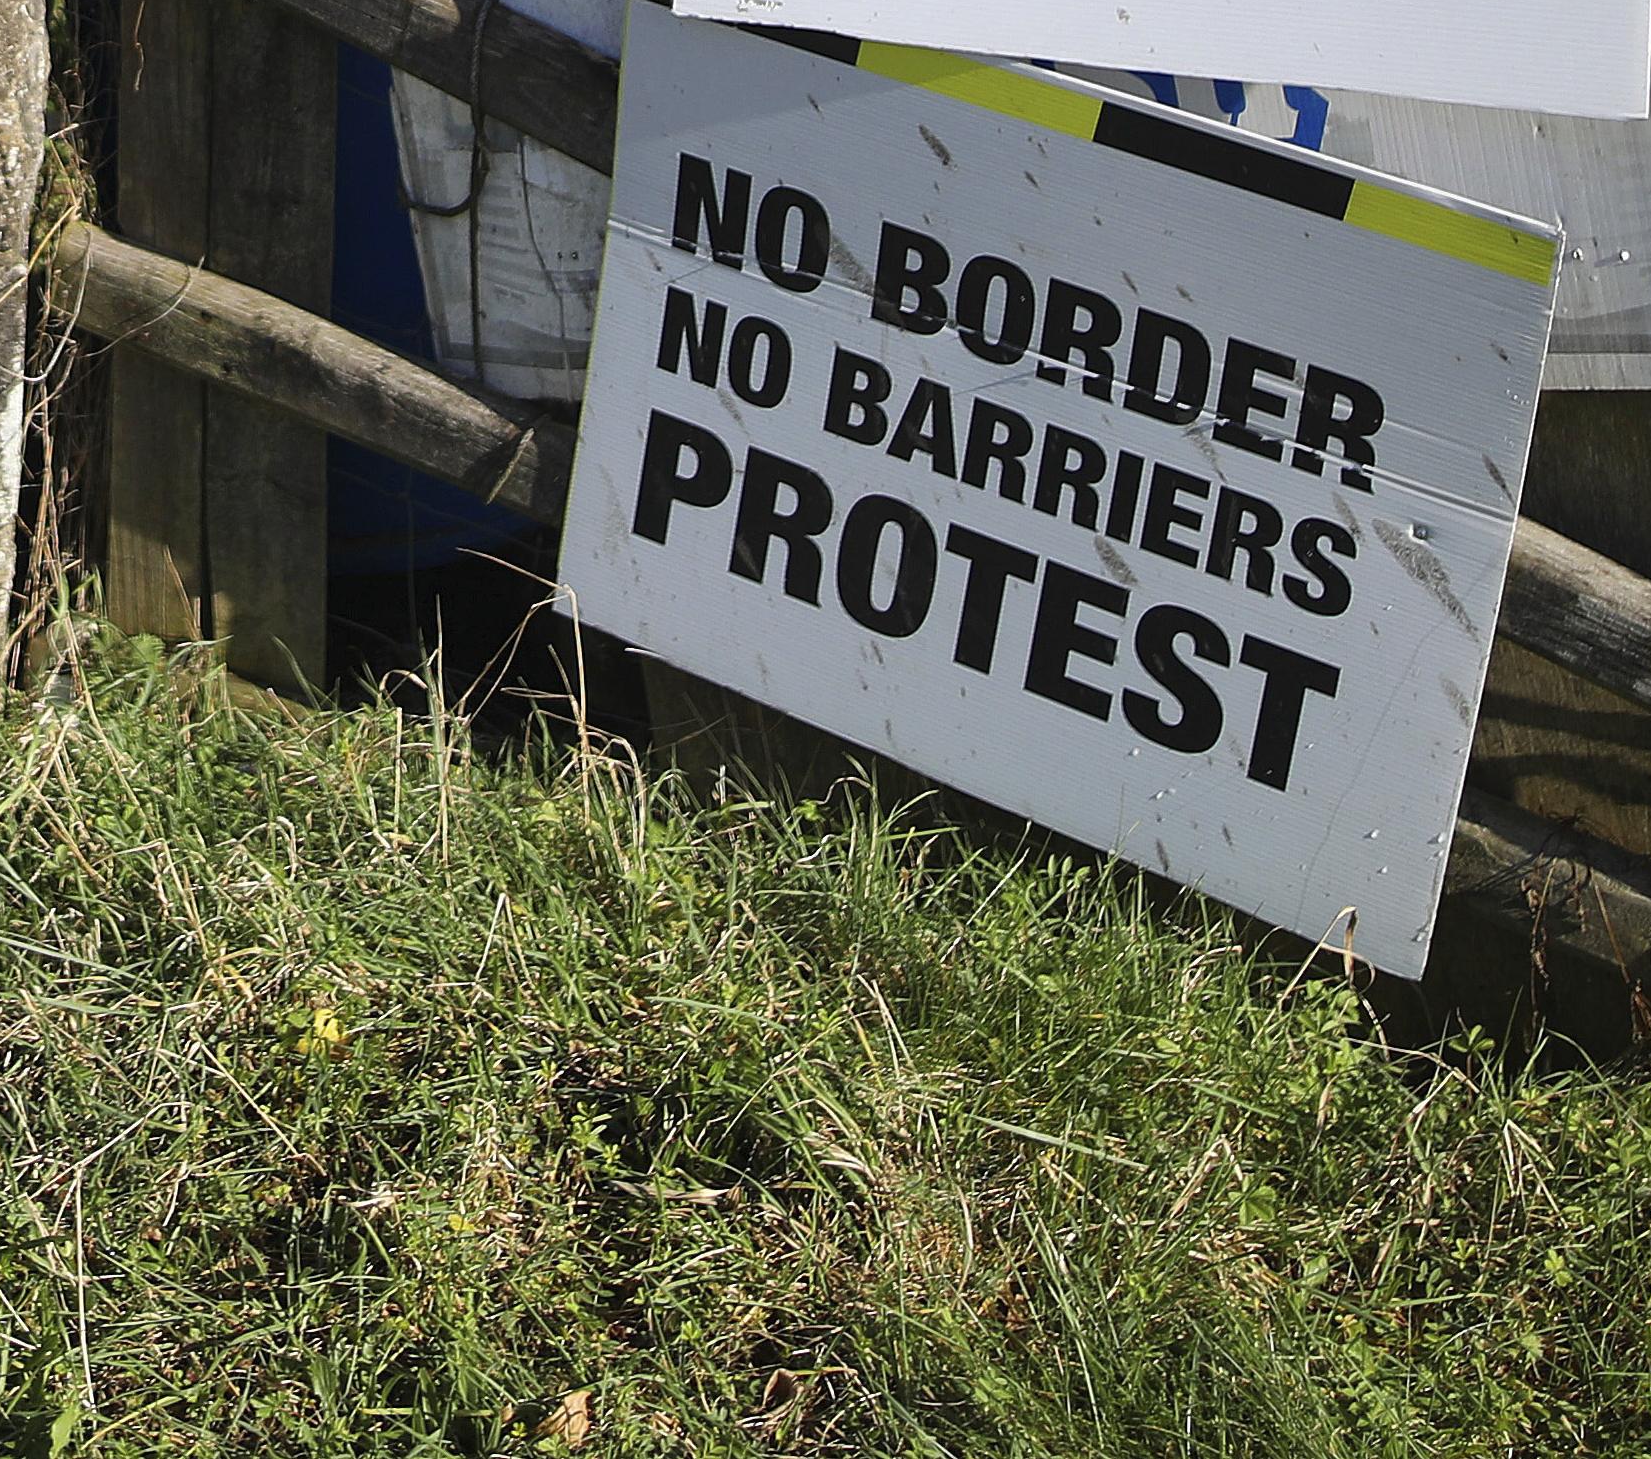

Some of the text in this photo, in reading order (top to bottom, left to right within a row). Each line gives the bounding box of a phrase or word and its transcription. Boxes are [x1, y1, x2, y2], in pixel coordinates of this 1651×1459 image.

[656, 284, 1357, 618] NO BARRIERS
[671, 152, 1385, 494] NO BORDER
[632, 407, 1342, 793] PROTEST
